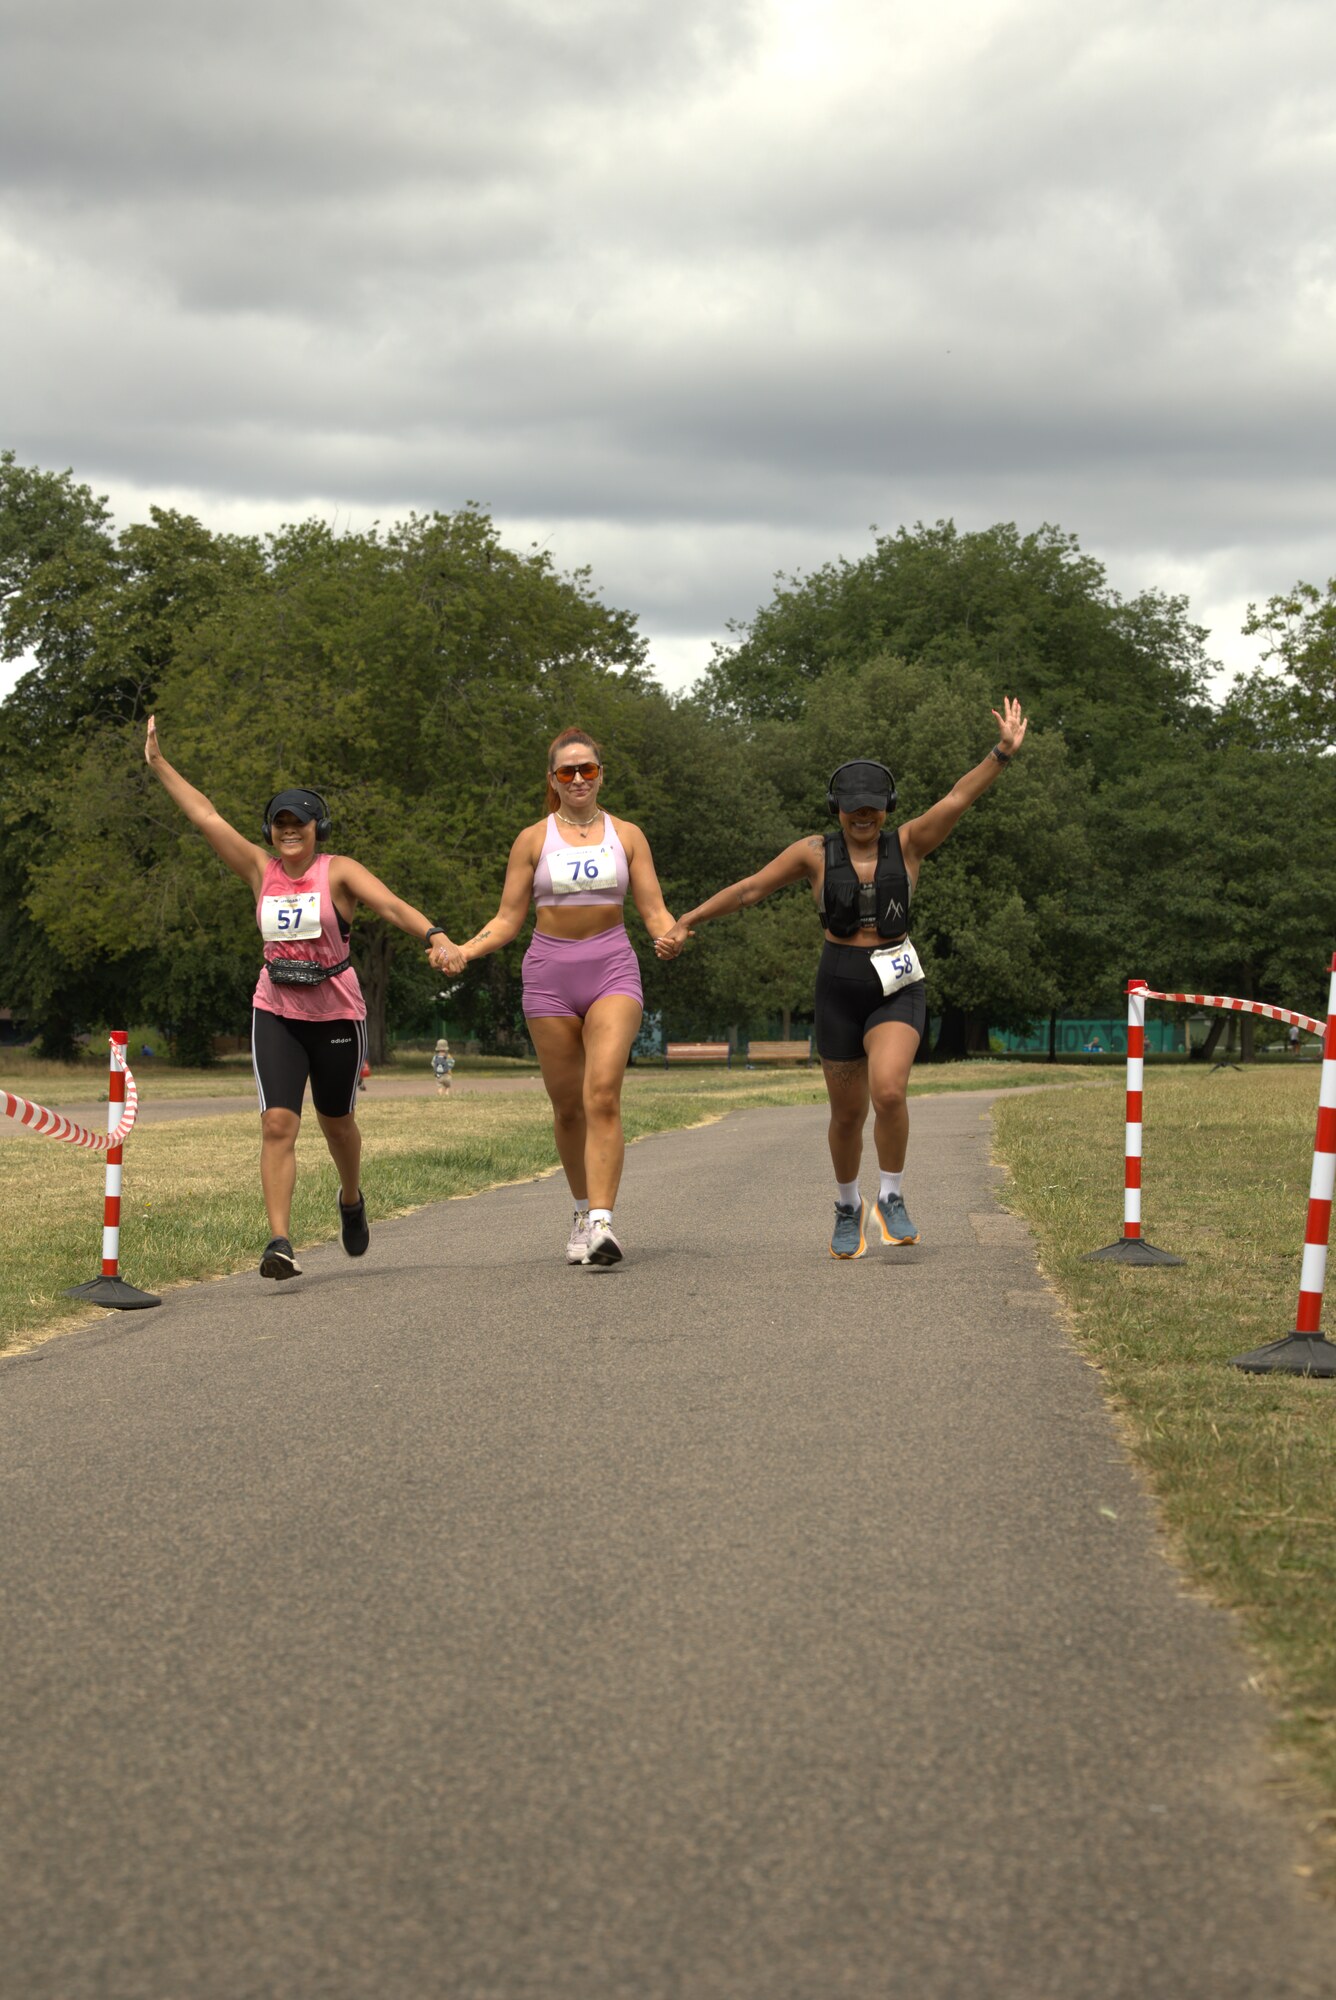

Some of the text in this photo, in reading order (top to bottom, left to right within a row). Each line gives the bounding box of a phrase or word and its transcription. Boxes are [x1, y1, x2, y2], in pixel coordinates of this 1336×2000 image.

[567, 859, 599, 881] 76
[278, 908, 303, 930] 57
[891, 953, 913, 979] 58
